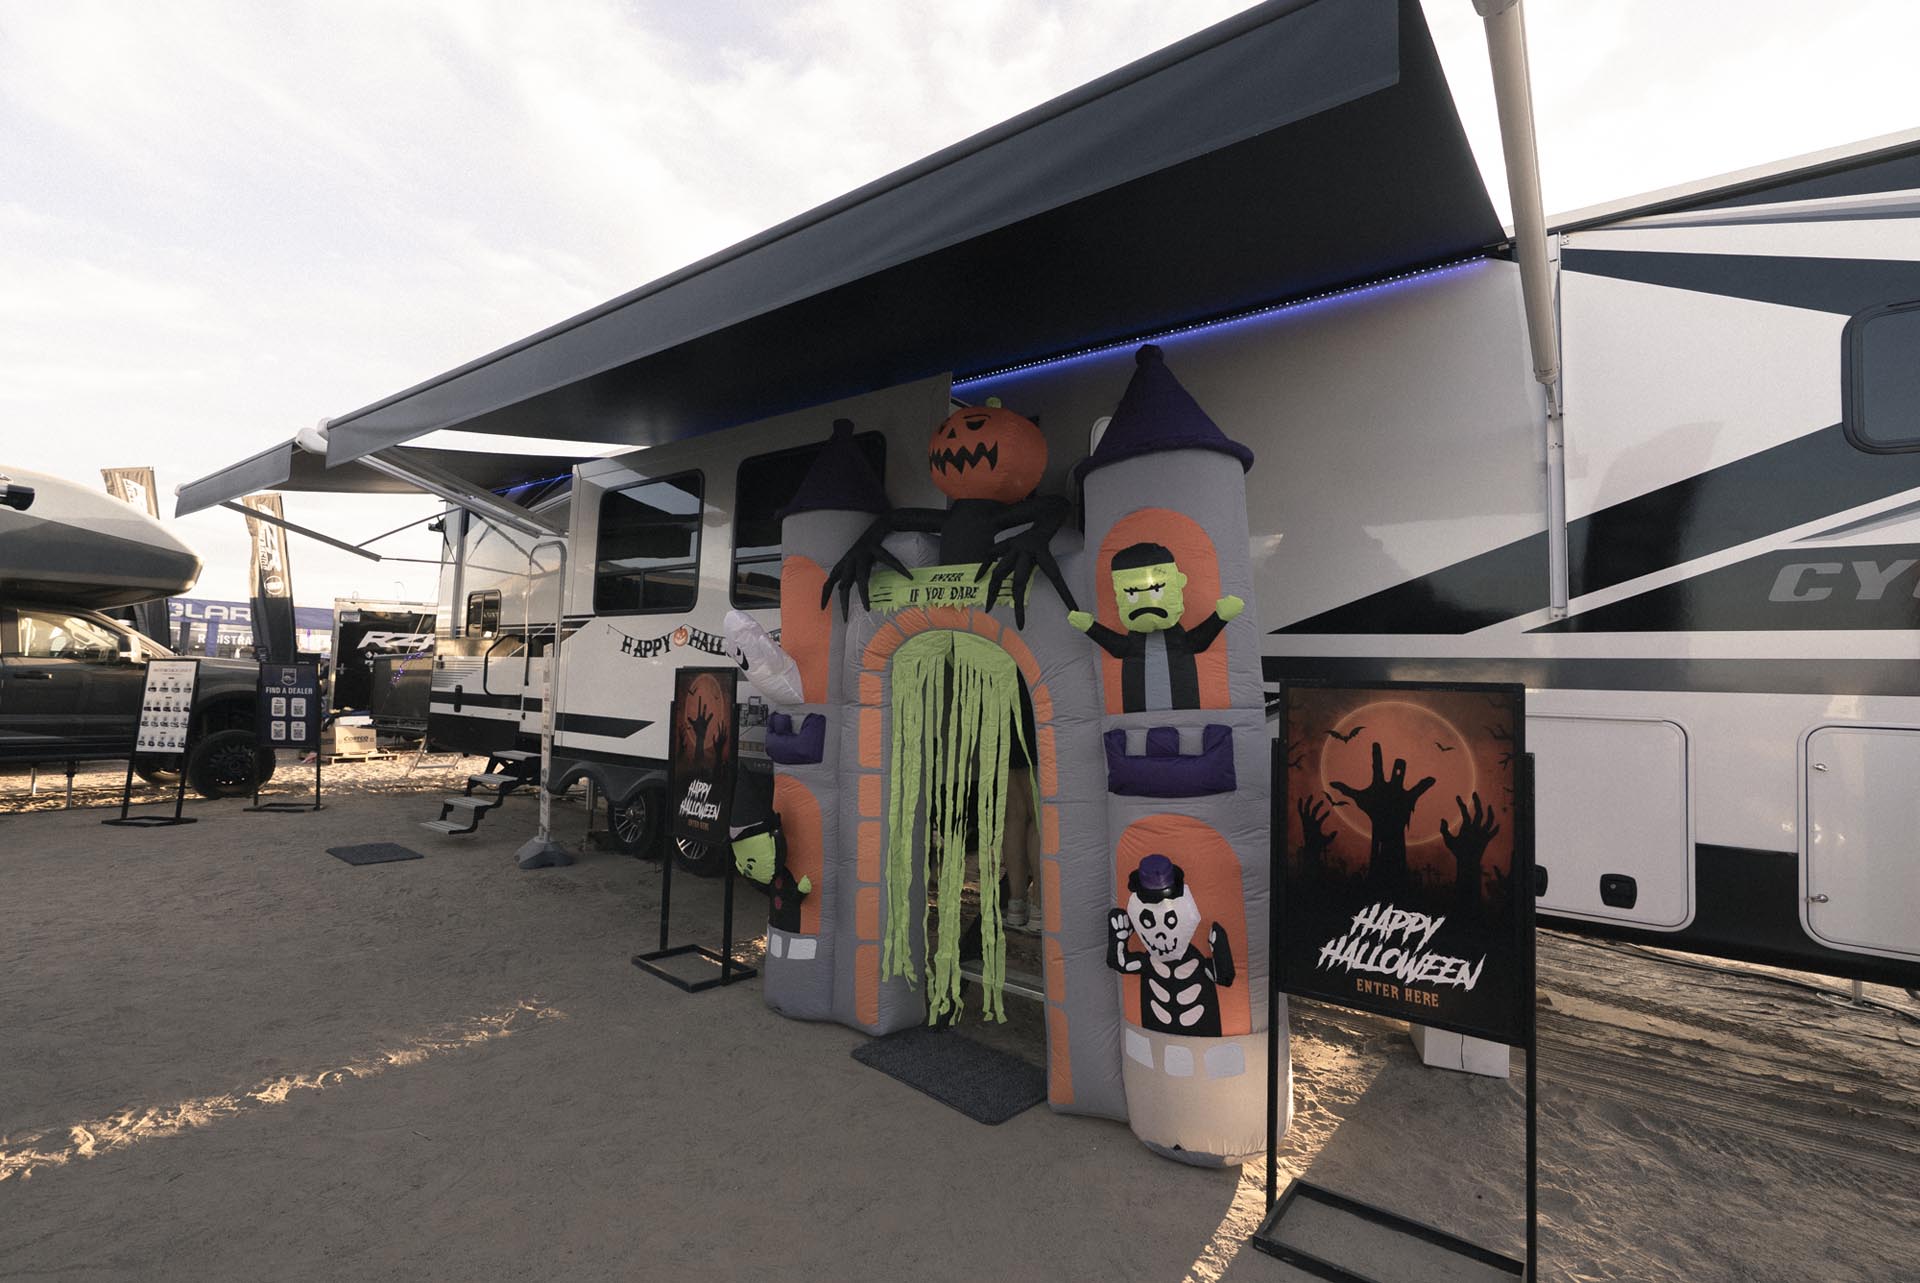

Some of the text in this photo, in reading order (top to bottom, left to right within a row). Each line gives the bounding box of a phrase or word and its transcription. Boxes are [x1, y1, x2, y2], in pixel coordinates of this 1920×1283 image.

[930, 572, 964, 582] ENTER
[1768, 559, 1920, 602] CY
[909, 586, 979, 602] IF YOU DARE
[168, 602, 251, 621] OLAR
[620, 627, 732, 658] HAPPY HALL
[265, 686, 313, 695] FIND A DEALER
[687, 779, 712, 803] HAPPY
[679, 797, 721, 821] HALLOWEEN
[1350, 901, 1446, 954] HAPPY
[1315, 935, 1487, 992] HALLOWEEN
[1356, 978, 1439, 1007] ENTER HERE
